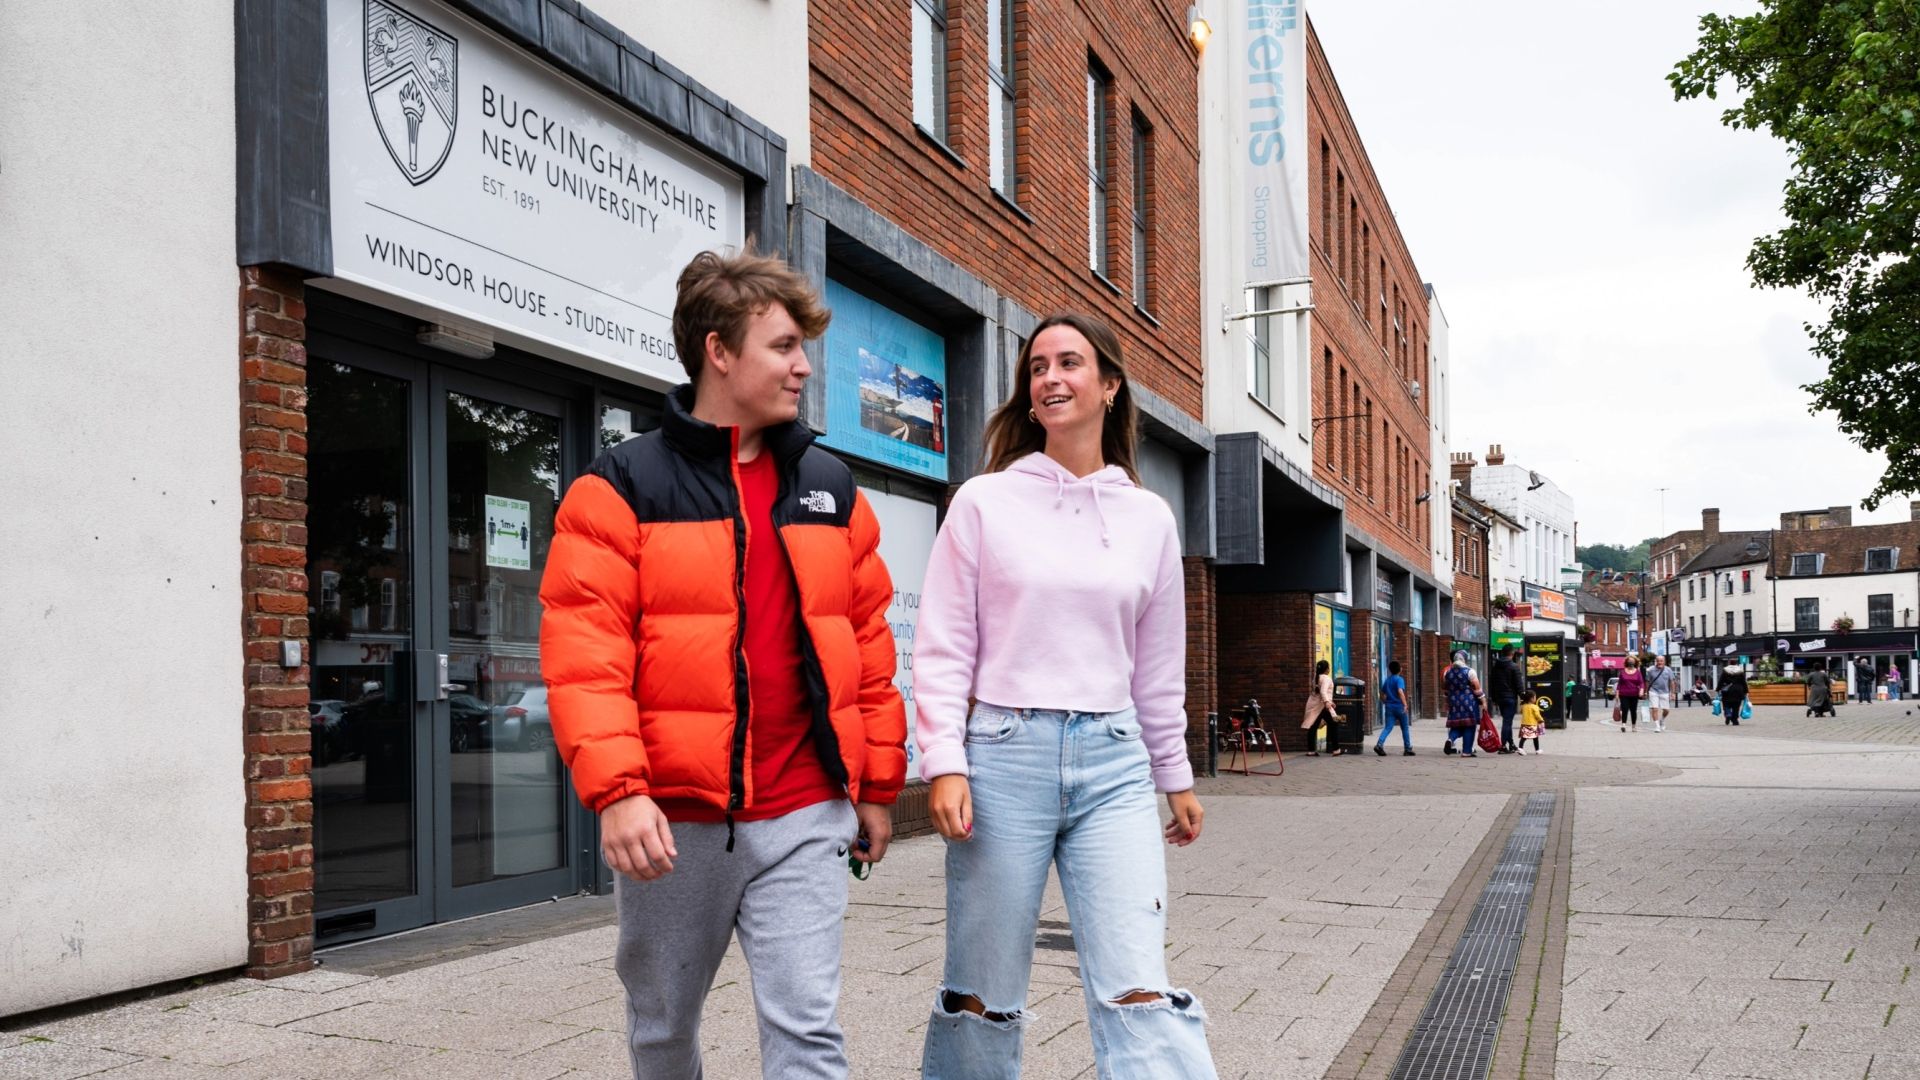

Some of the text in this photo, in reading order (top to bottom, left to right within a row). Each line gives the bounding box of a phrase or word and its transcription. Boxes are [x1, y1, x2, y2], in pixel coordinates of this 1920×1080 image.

[482, 84, 717, 231] BUCKINGHAMSHIRE
[482, 129, 659, 233] NEW UNIVERSITY
[482, 175, 540, 215] EST. 1891
[1251, 185, 1271, 268] Shopping
[365, 233, 476, 293] WINDSOR
[483, 274, 547, 317] HOUSE
[565, 305, 635, 347] STUDENT
[640, 332, 681, 363] RESID
[799, 496, 825, 506] NORTH
[808, 504, 827, 513] FACE
[809, 490, 825, 499] THE
[500, 519, 516, 529] 1m+
